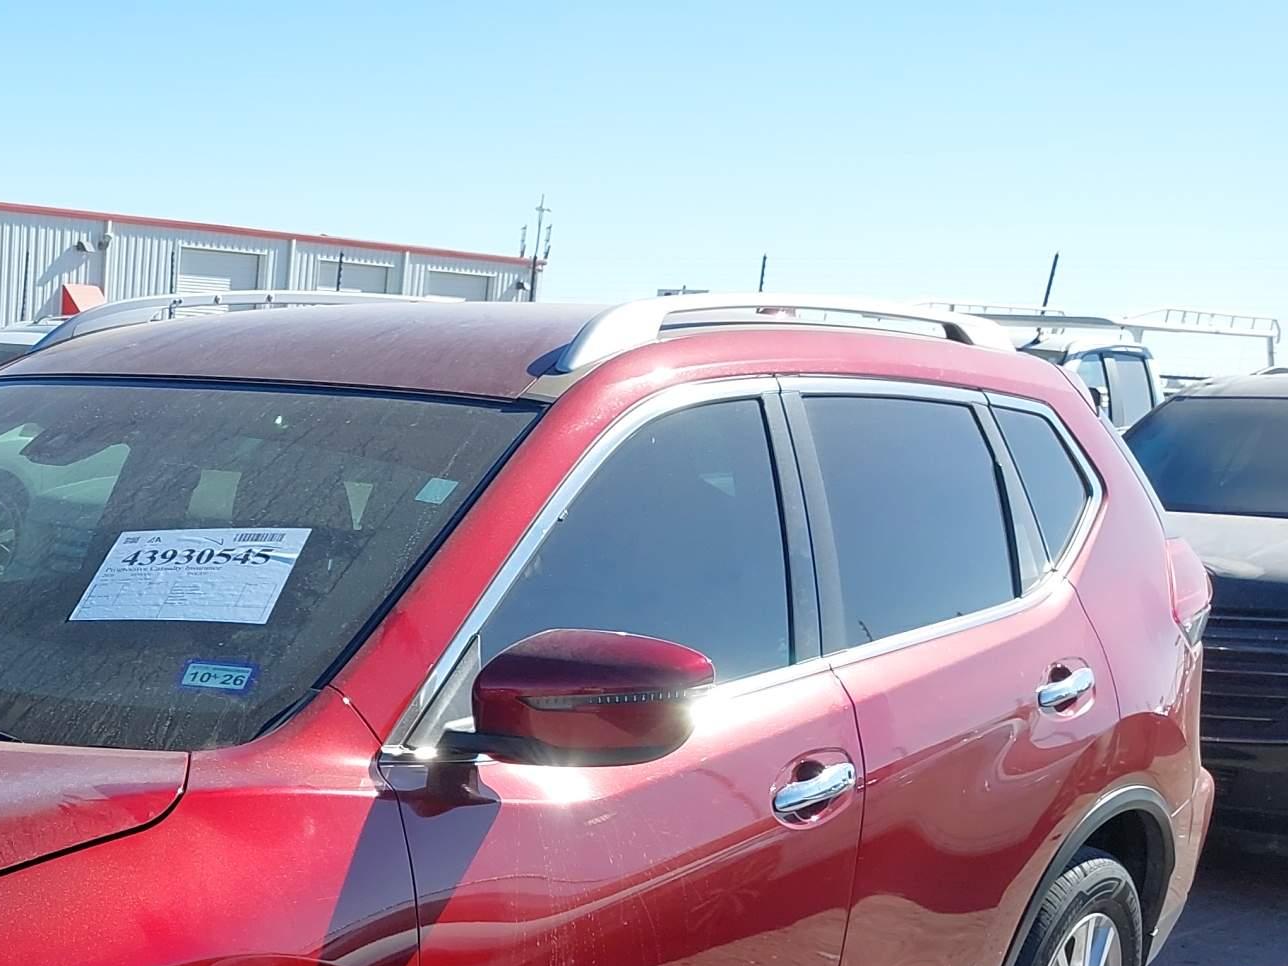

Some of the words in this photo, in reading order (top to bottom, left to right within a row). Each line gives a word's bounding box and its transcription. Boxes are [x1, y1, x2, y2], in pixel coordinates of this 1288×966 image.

[121, 548, 276, 567] 43930545
[189, 671, 212, 683] 10
[219, 674, 245, 686] 26
